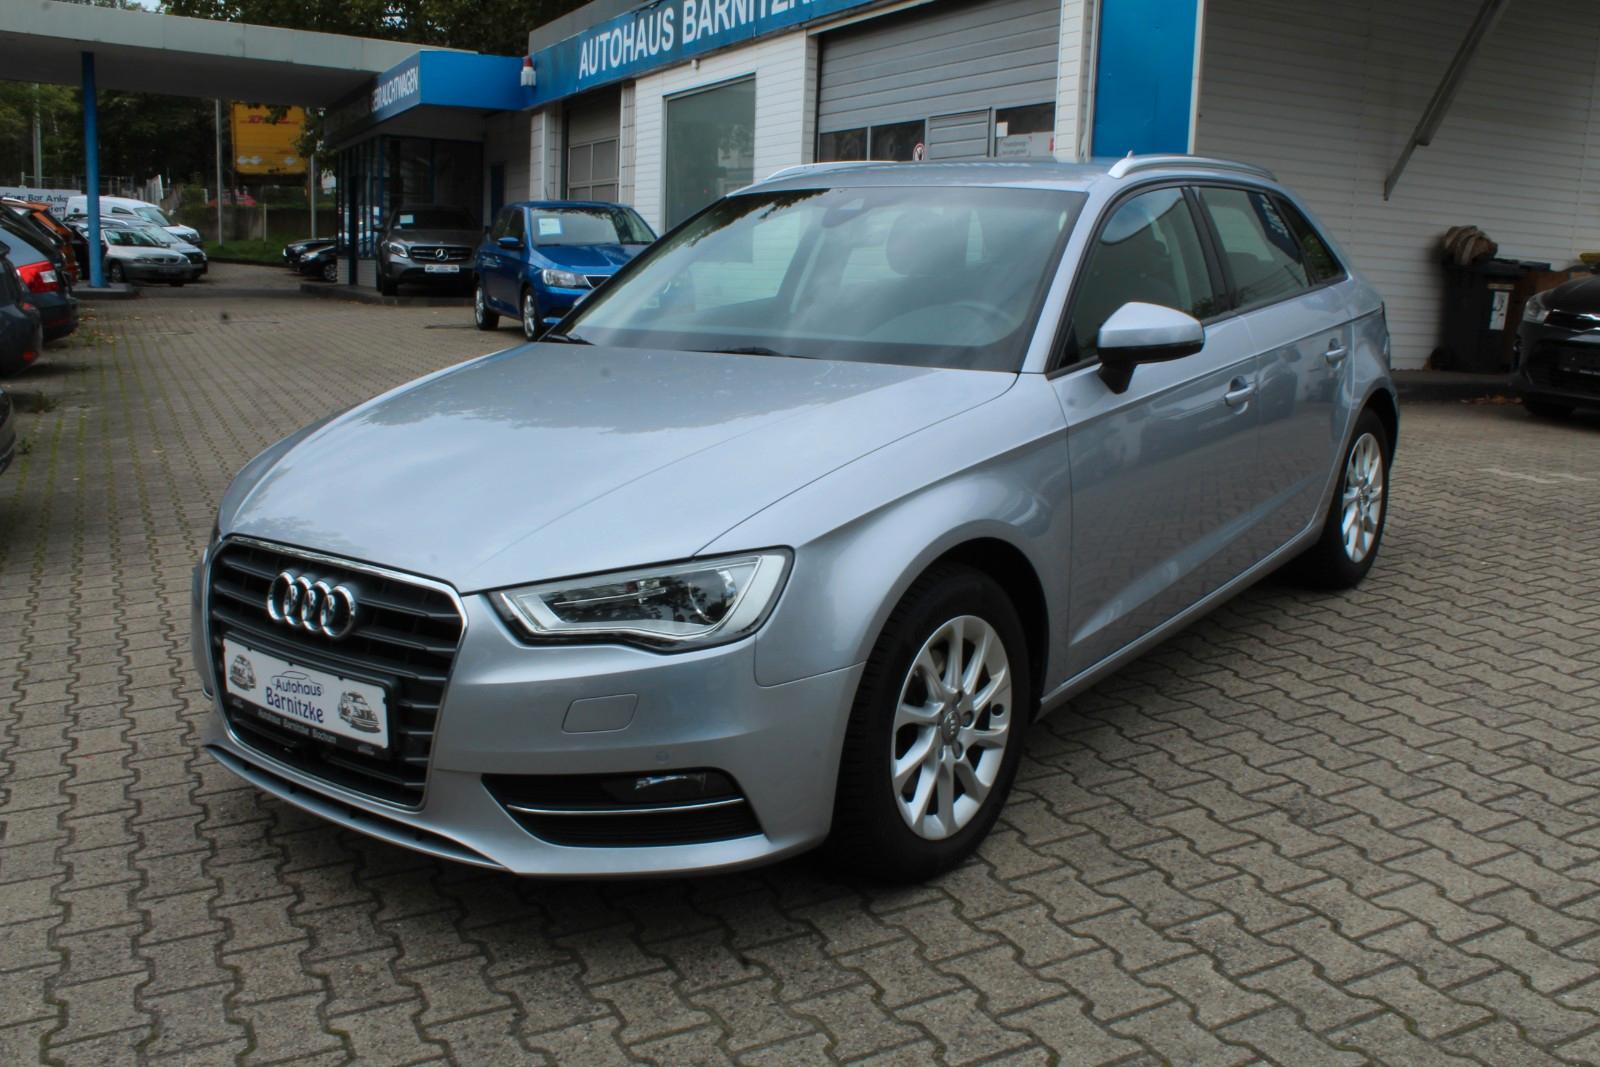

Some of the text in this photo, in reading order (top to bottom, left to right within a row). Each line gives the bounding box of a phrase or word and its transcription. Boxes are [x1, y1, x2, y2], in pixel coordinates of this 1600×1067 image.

[578, 0, 816, 80] AUTOHAUS BARNI
[266, 686, 324, 724] Barnitzke
[275, 678, 322, 697] Autohaus
